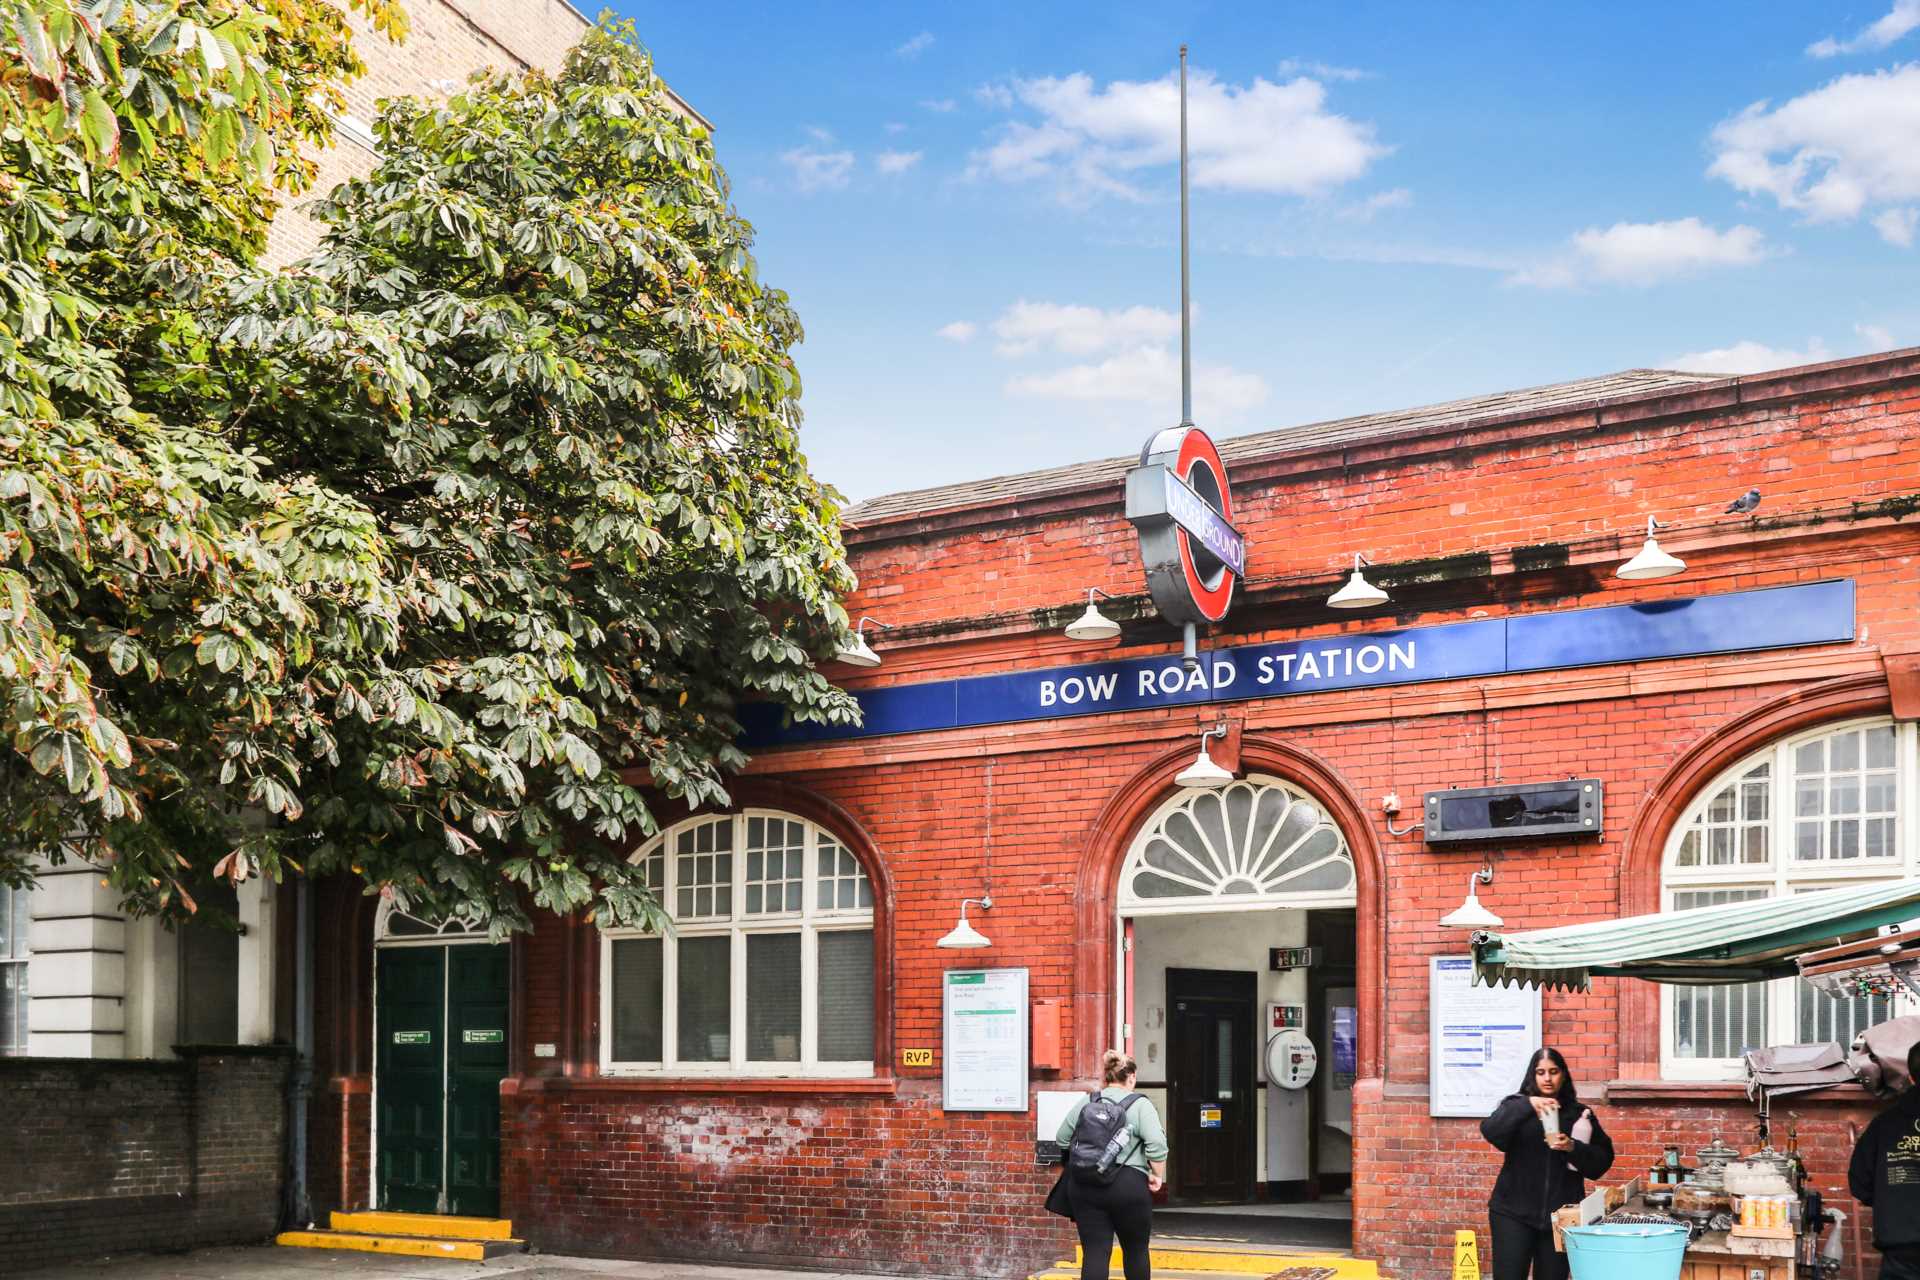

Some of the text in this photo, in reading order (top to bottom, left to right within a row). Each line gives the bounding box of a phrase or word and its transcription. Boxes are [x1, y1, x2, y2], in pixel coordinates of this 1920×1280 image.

[1167, 474, 1241, 567] UNDERGROUND
[1040, 641, 1415, 707] BOW ROAD STATION
[906, 1051, 930, 1063] RVP
